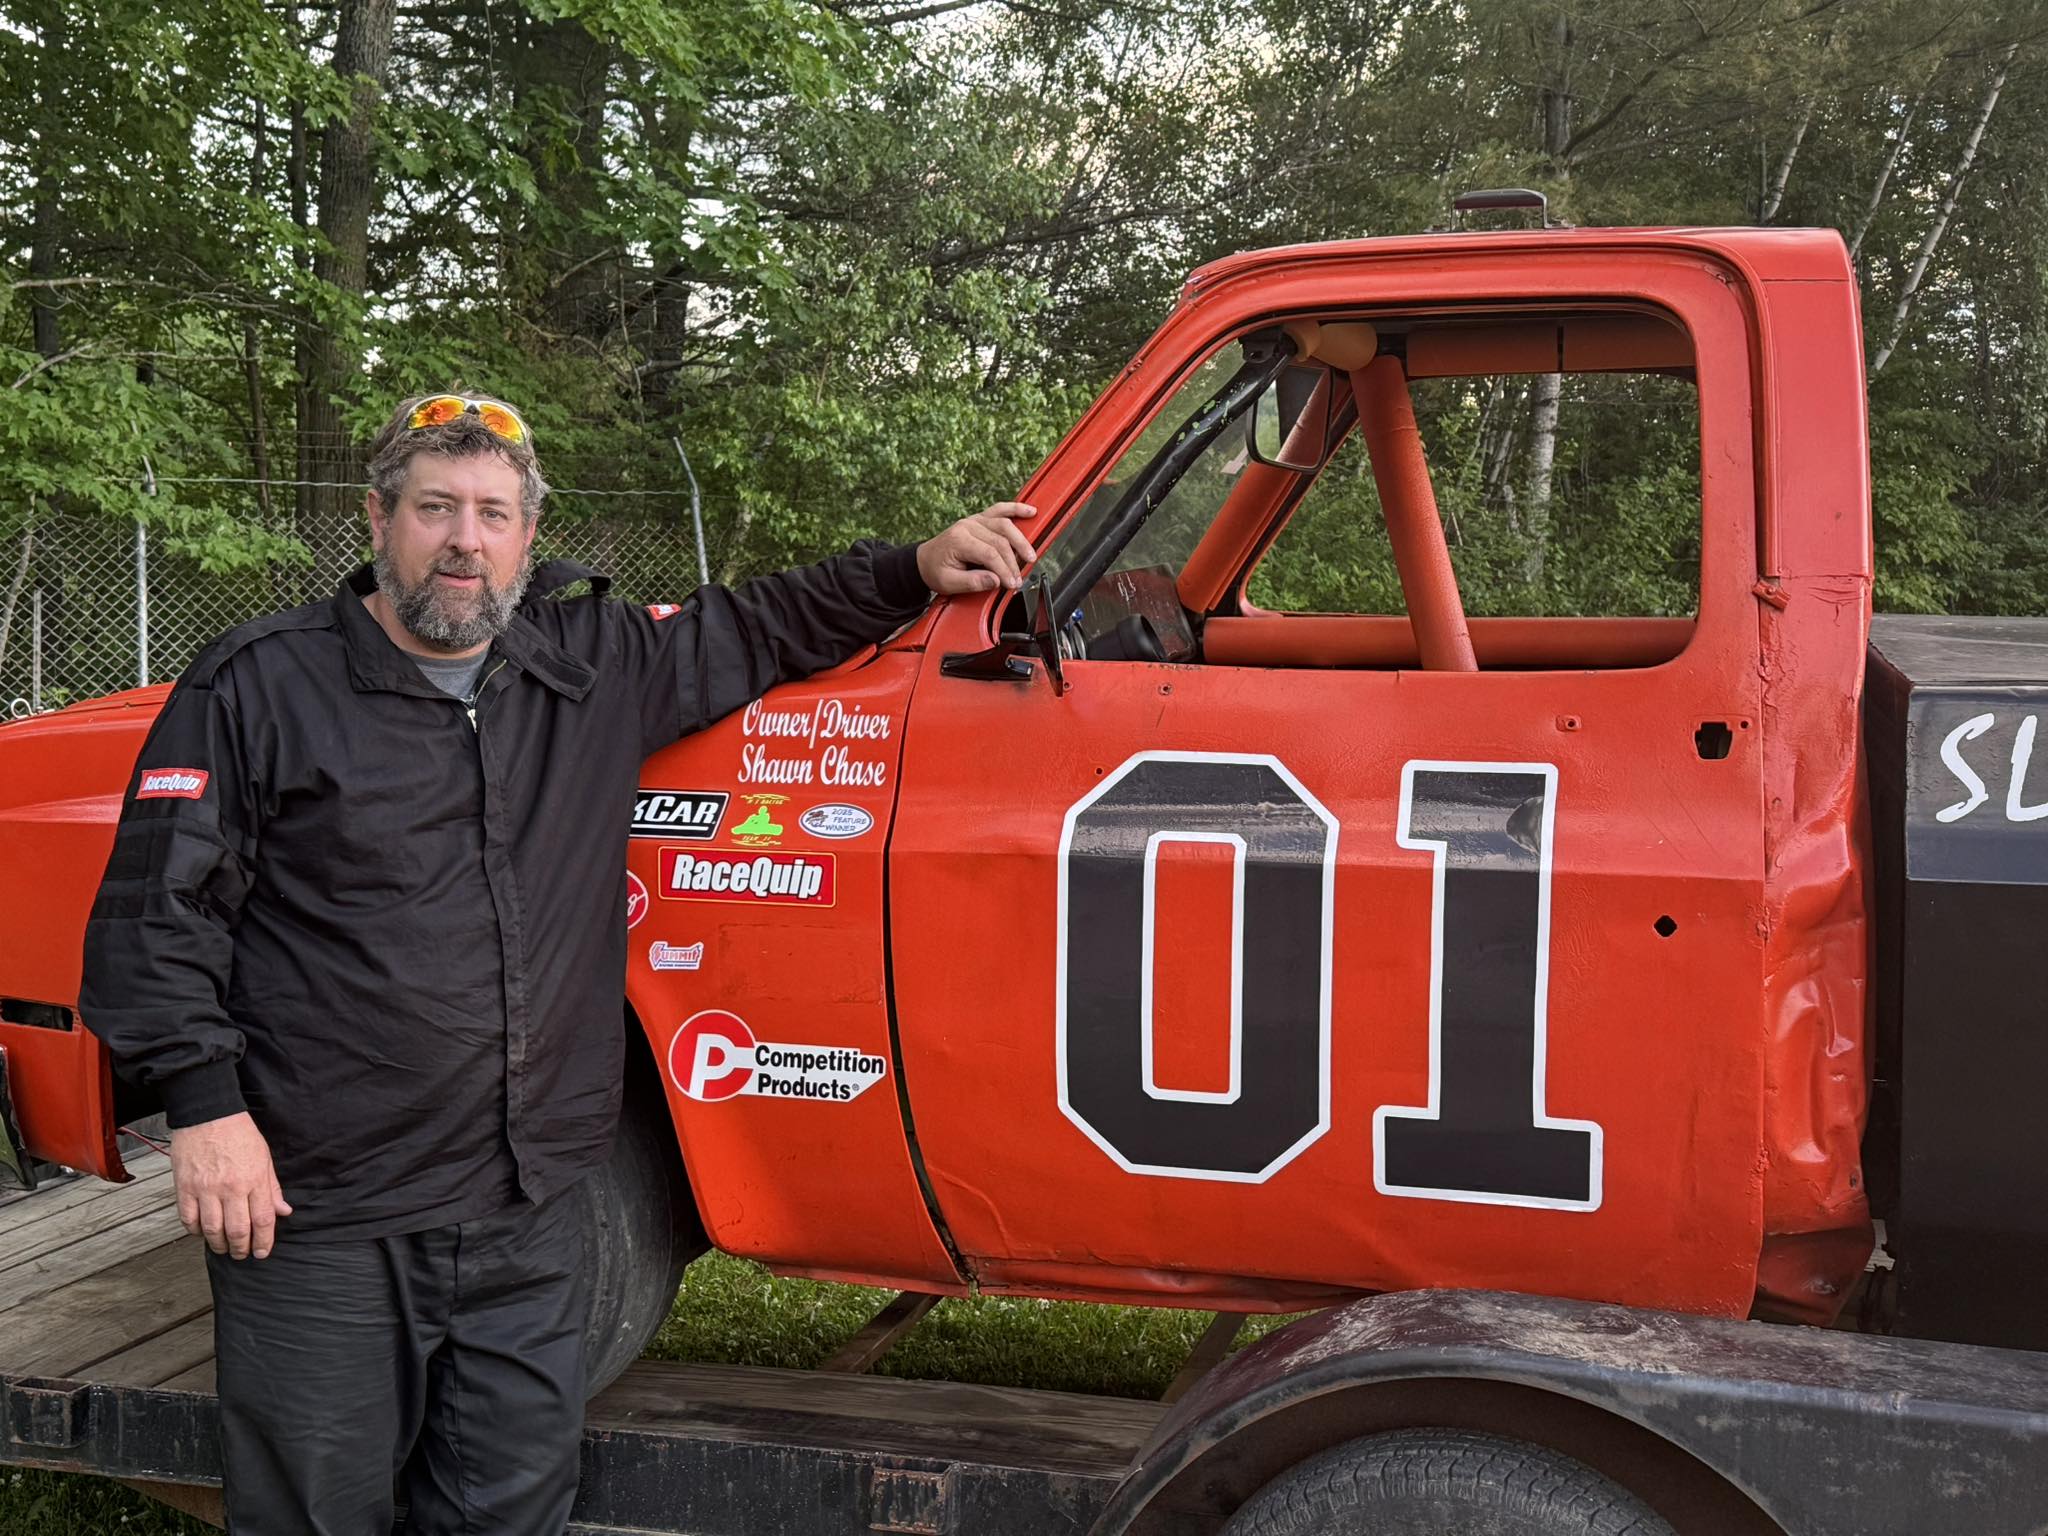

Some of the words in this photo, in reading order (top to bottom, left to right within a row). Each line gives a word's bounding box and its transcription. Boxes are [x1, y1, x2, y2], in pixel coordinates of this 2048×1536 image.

[743, 698, 891, 749] Owner/Driver
[738, 743, 814, 783] Shawn
[820, 745, 886, 786] Chase
[825, 824, 856, 832] WINNER
[833, 816, 867, 825] FEATURE
[671, 853, 822, 899] RaceQuip
[1056, 750, 1603, 1212] 01
[755, 1044, 884, 1074] Competition
